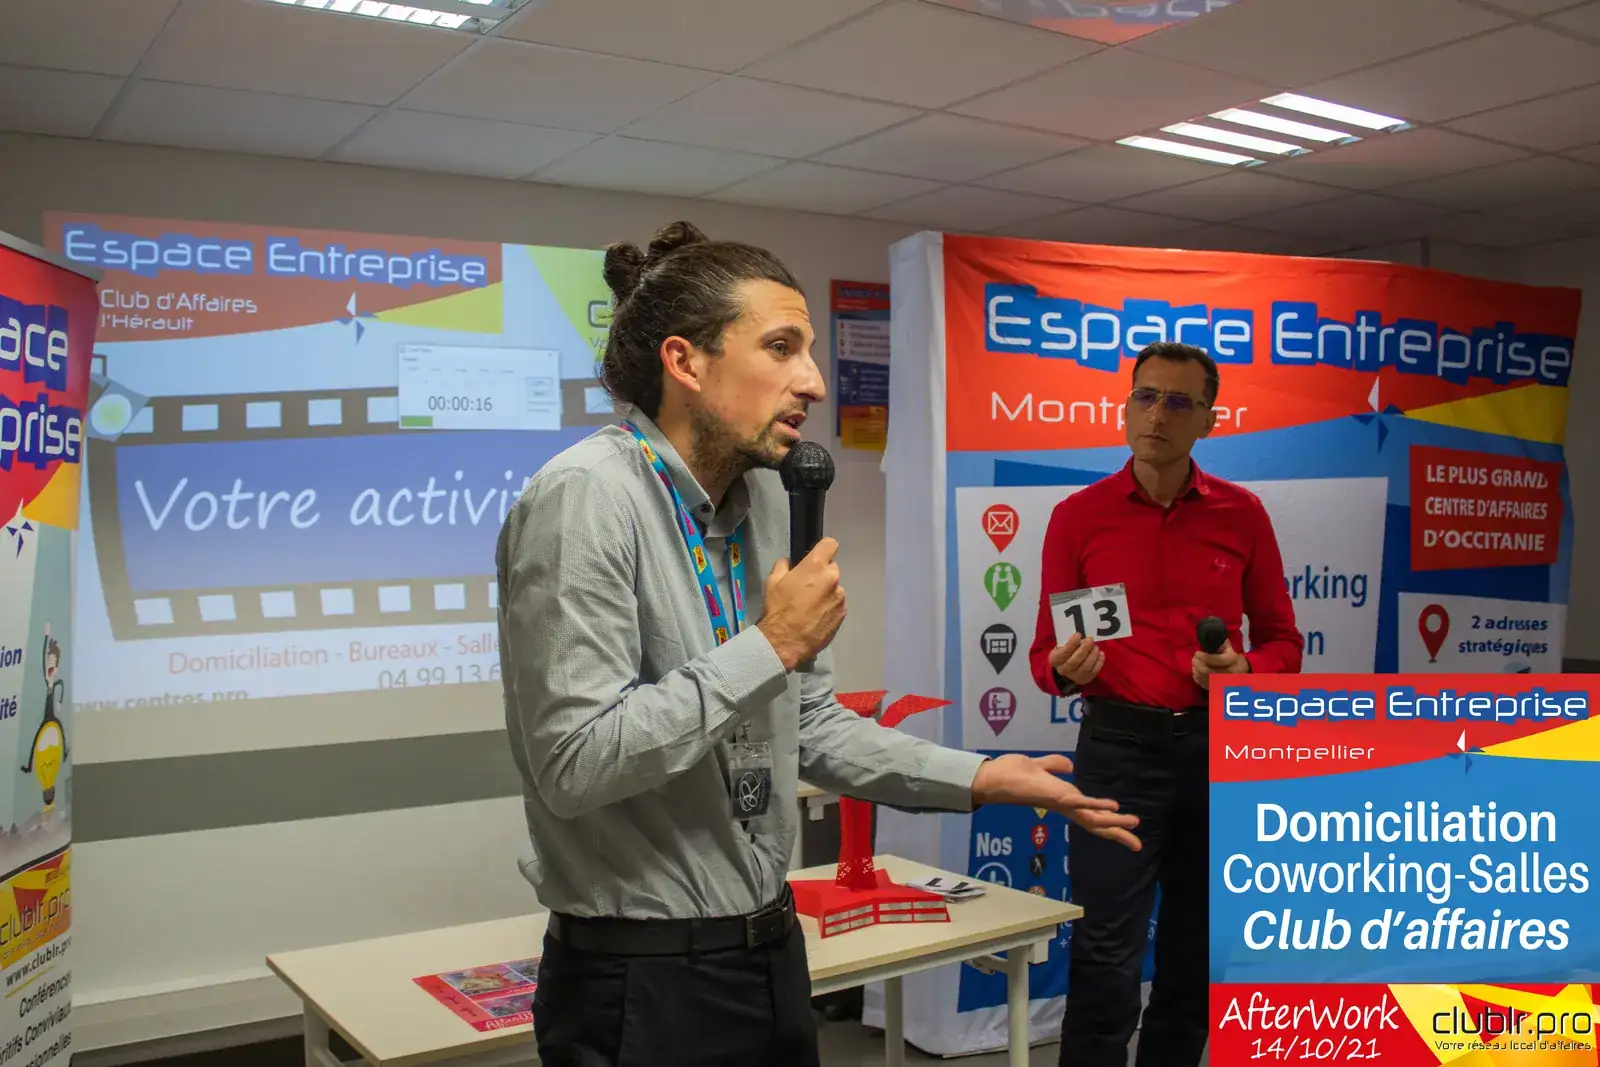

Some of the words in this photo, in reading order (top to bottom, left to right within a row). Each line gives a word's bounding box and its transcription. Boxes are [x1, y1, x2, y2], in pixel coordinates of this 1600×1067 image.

[65, 230, 252, 272] Espace
[269, 242, 486, 284] Entreprise
[101, 289, 150, 309] Club
[157, 293, 258, 313] d'Affaires
[101, 314, 195, 331] l'Hérault
[988, 295, 1251, 361] Espace
[1275, 311, 1571, 379] Entreprise
[428, 395, 493, 412] 00:00:16
[991, 391, 1248, 431] Monter
[1426, 464, 1445, 482] LE
[1449, 465, 1487, 486] PLUS
[1491, 469, 1549, 490] GRAND
[135, 477, 320, 532] Votre
[1425, 496, 1475, 516] CENTRE
[1477, 499, 1548, 520] D'AFFAIRES
[1423, 529, 1545, 551] D'OCCITANIE
[1063, 599, 1122, 640] 13
[1471, 615, 1481, 630] 2
[1485, 616, 1548, 631] adresses
[169, 644, 328, 675] Domiciliation
[349, 640, 438, 663] Bureaux
[1459, 638, 1548, 658] stratégiques
[378, 669, 408, 689] 04
[417, 666, 446, 685] 99
[455, 664, 482, 683] 13
[976, 832, 1013, 857] Nos
